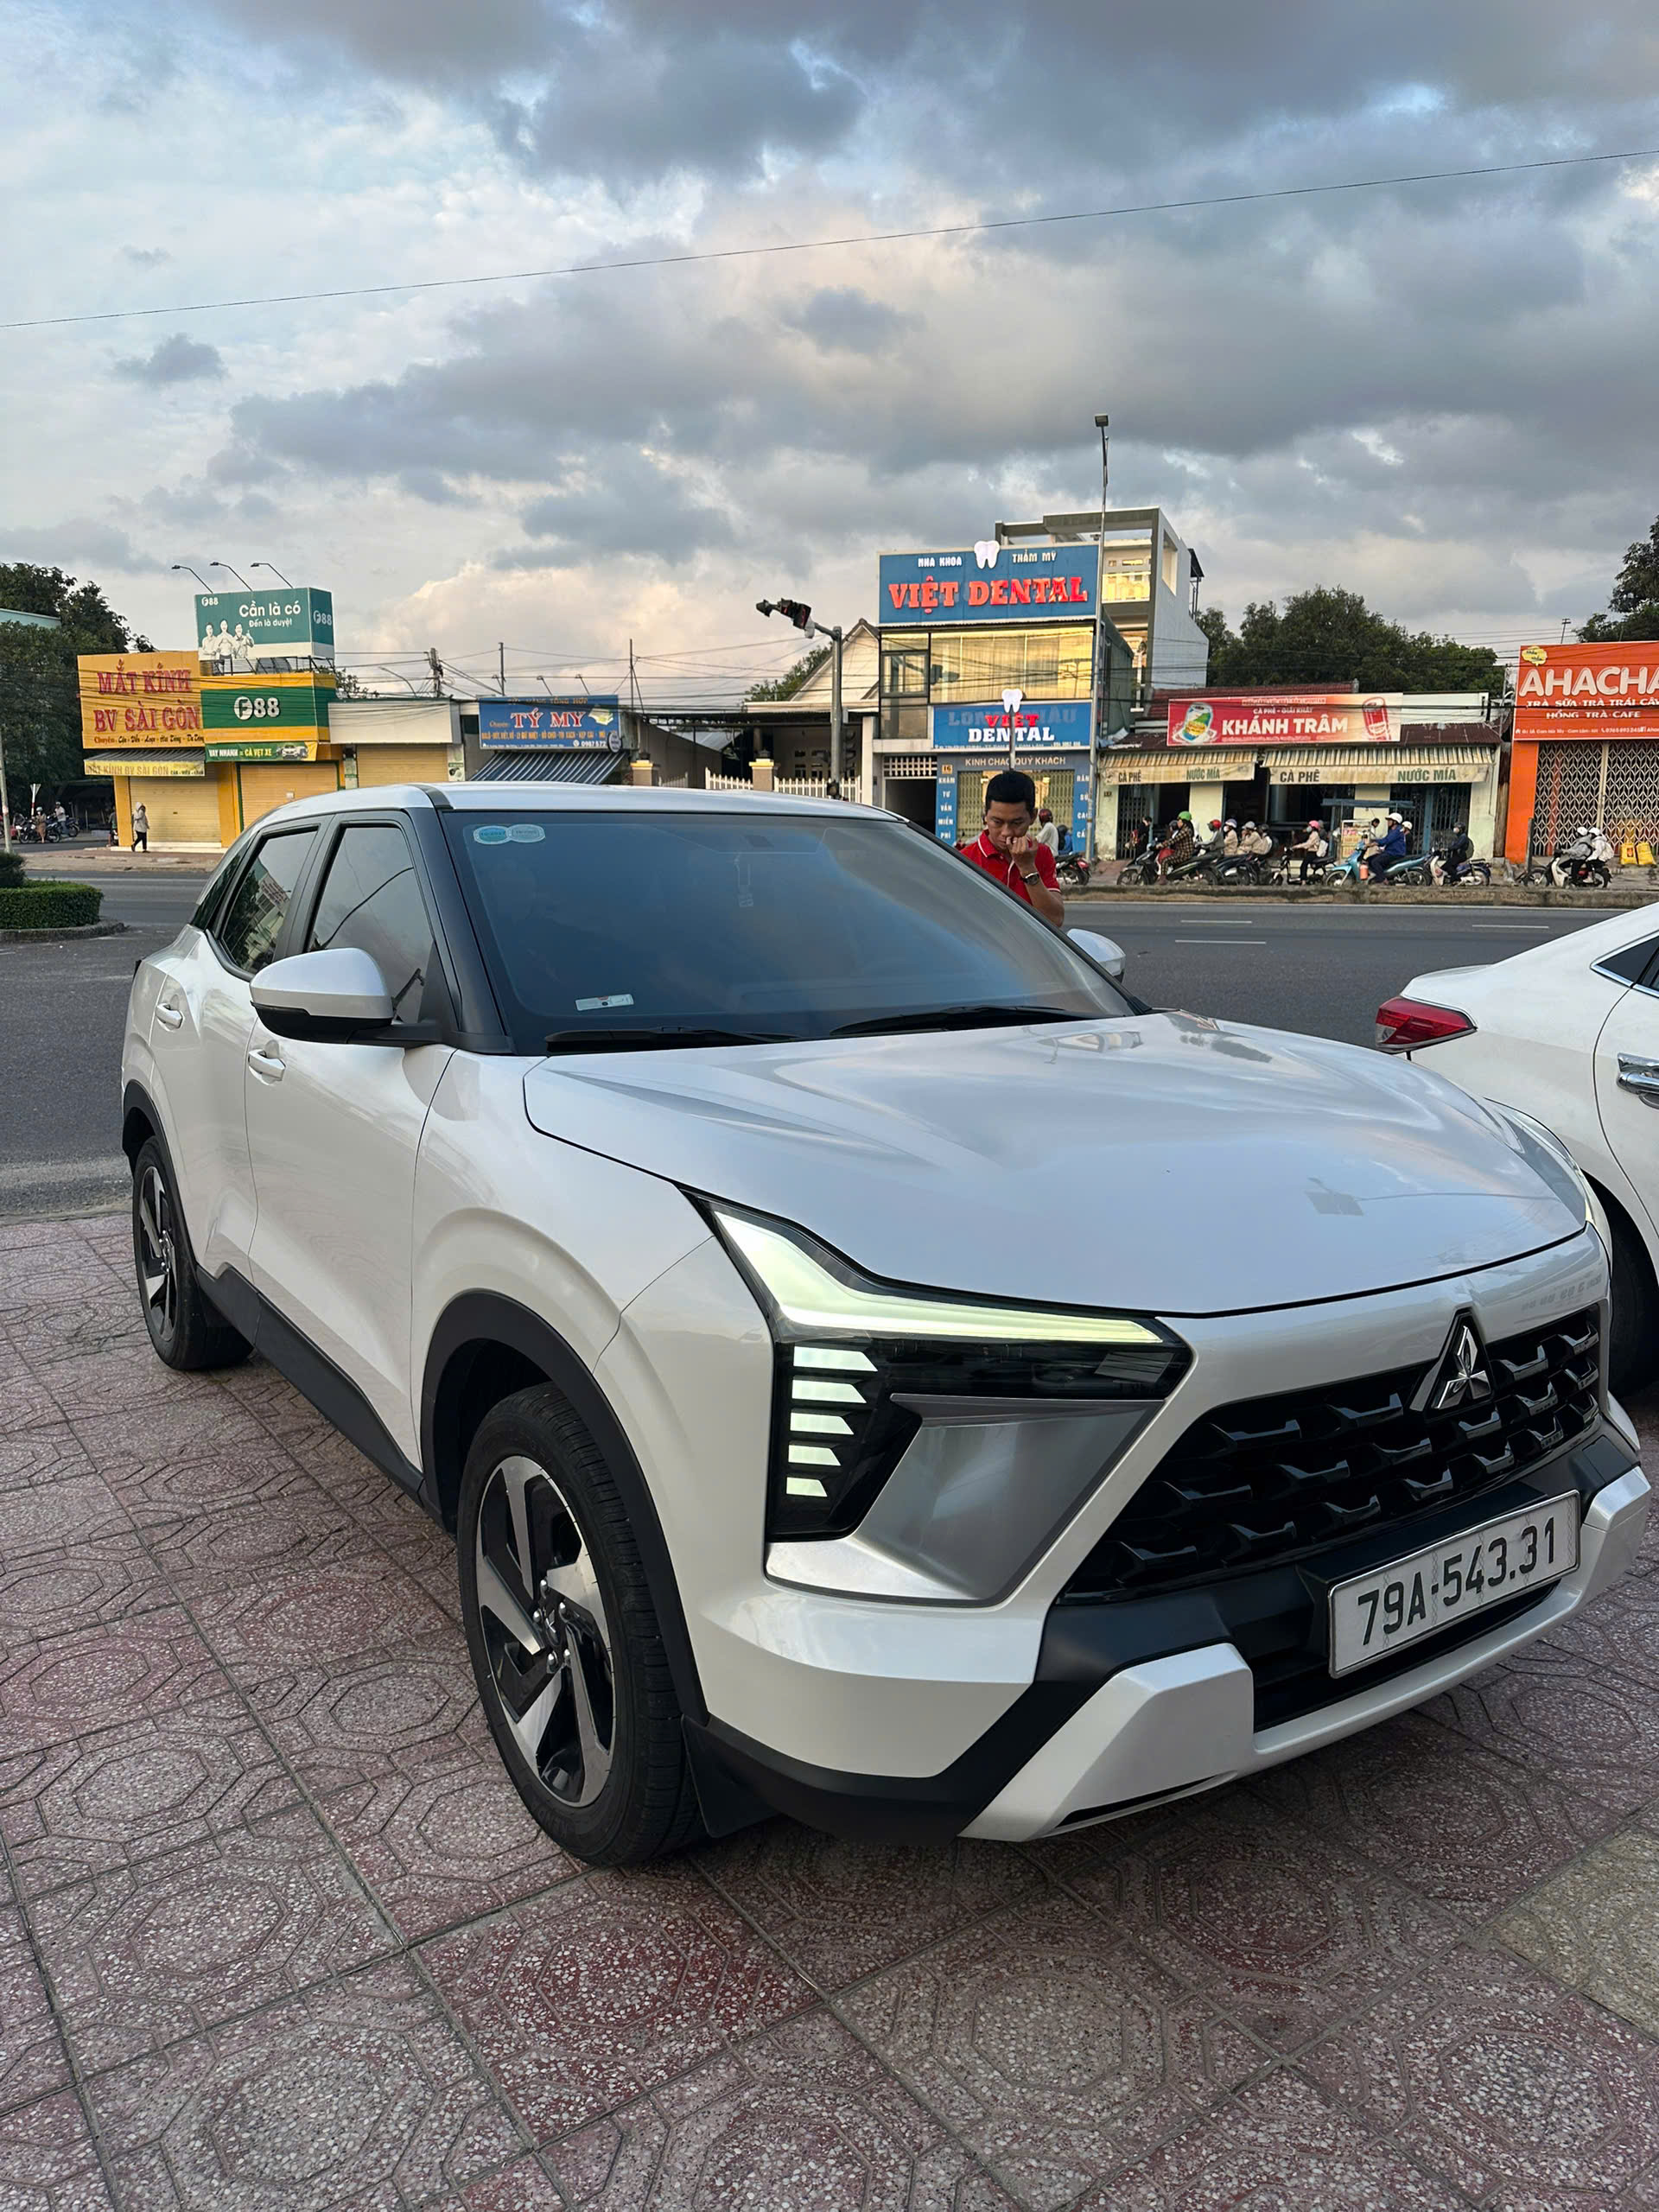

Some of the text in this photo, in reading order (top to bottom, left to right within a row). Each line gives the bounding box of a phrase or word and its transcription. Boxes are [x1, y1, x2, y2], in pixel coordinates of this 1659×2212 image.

[918, 556, 963, 568] NHA KHOA
[201, 596, 219, 607] F88
[888, 575, 1088, 614] VIỆT DENTAL
[238, 601, 301, 617] Cần là có
[313, 610, 333, 626] F88
[142, 662, 193, 693] KÍNH
[233, 696, 280, 721] F88
[1555, 697, 1577, 707] SỮA
[1582, 698, 1605, 707] TRÀ
[93, 698, 200, 732] BV SÀI GÒN
[550, 711, 586, 728] MY
[1586, 709, 1608, 718] TRÀ
[1222, 715, 1348, 735] KHÁNH TRÂM
[968, 727, 1055, 743] DENTAL
[208, 748, 219, 757] VAY
[219, 748, 238, 757] NHANH
[244, 747, 253, 756] CÀ
[264, 747, 272, 756] XE
[1118, 771, 1141, 782] CÀ PHÊ
[1207, 767, 1220, 779] MÍA
[1280, 769, 1320, 783] CÀ PHÊ
[1398, 769, 1457, 782] NƯỚC MÍA
[1357, 1516, 1554, 1646] 79A-543.31
